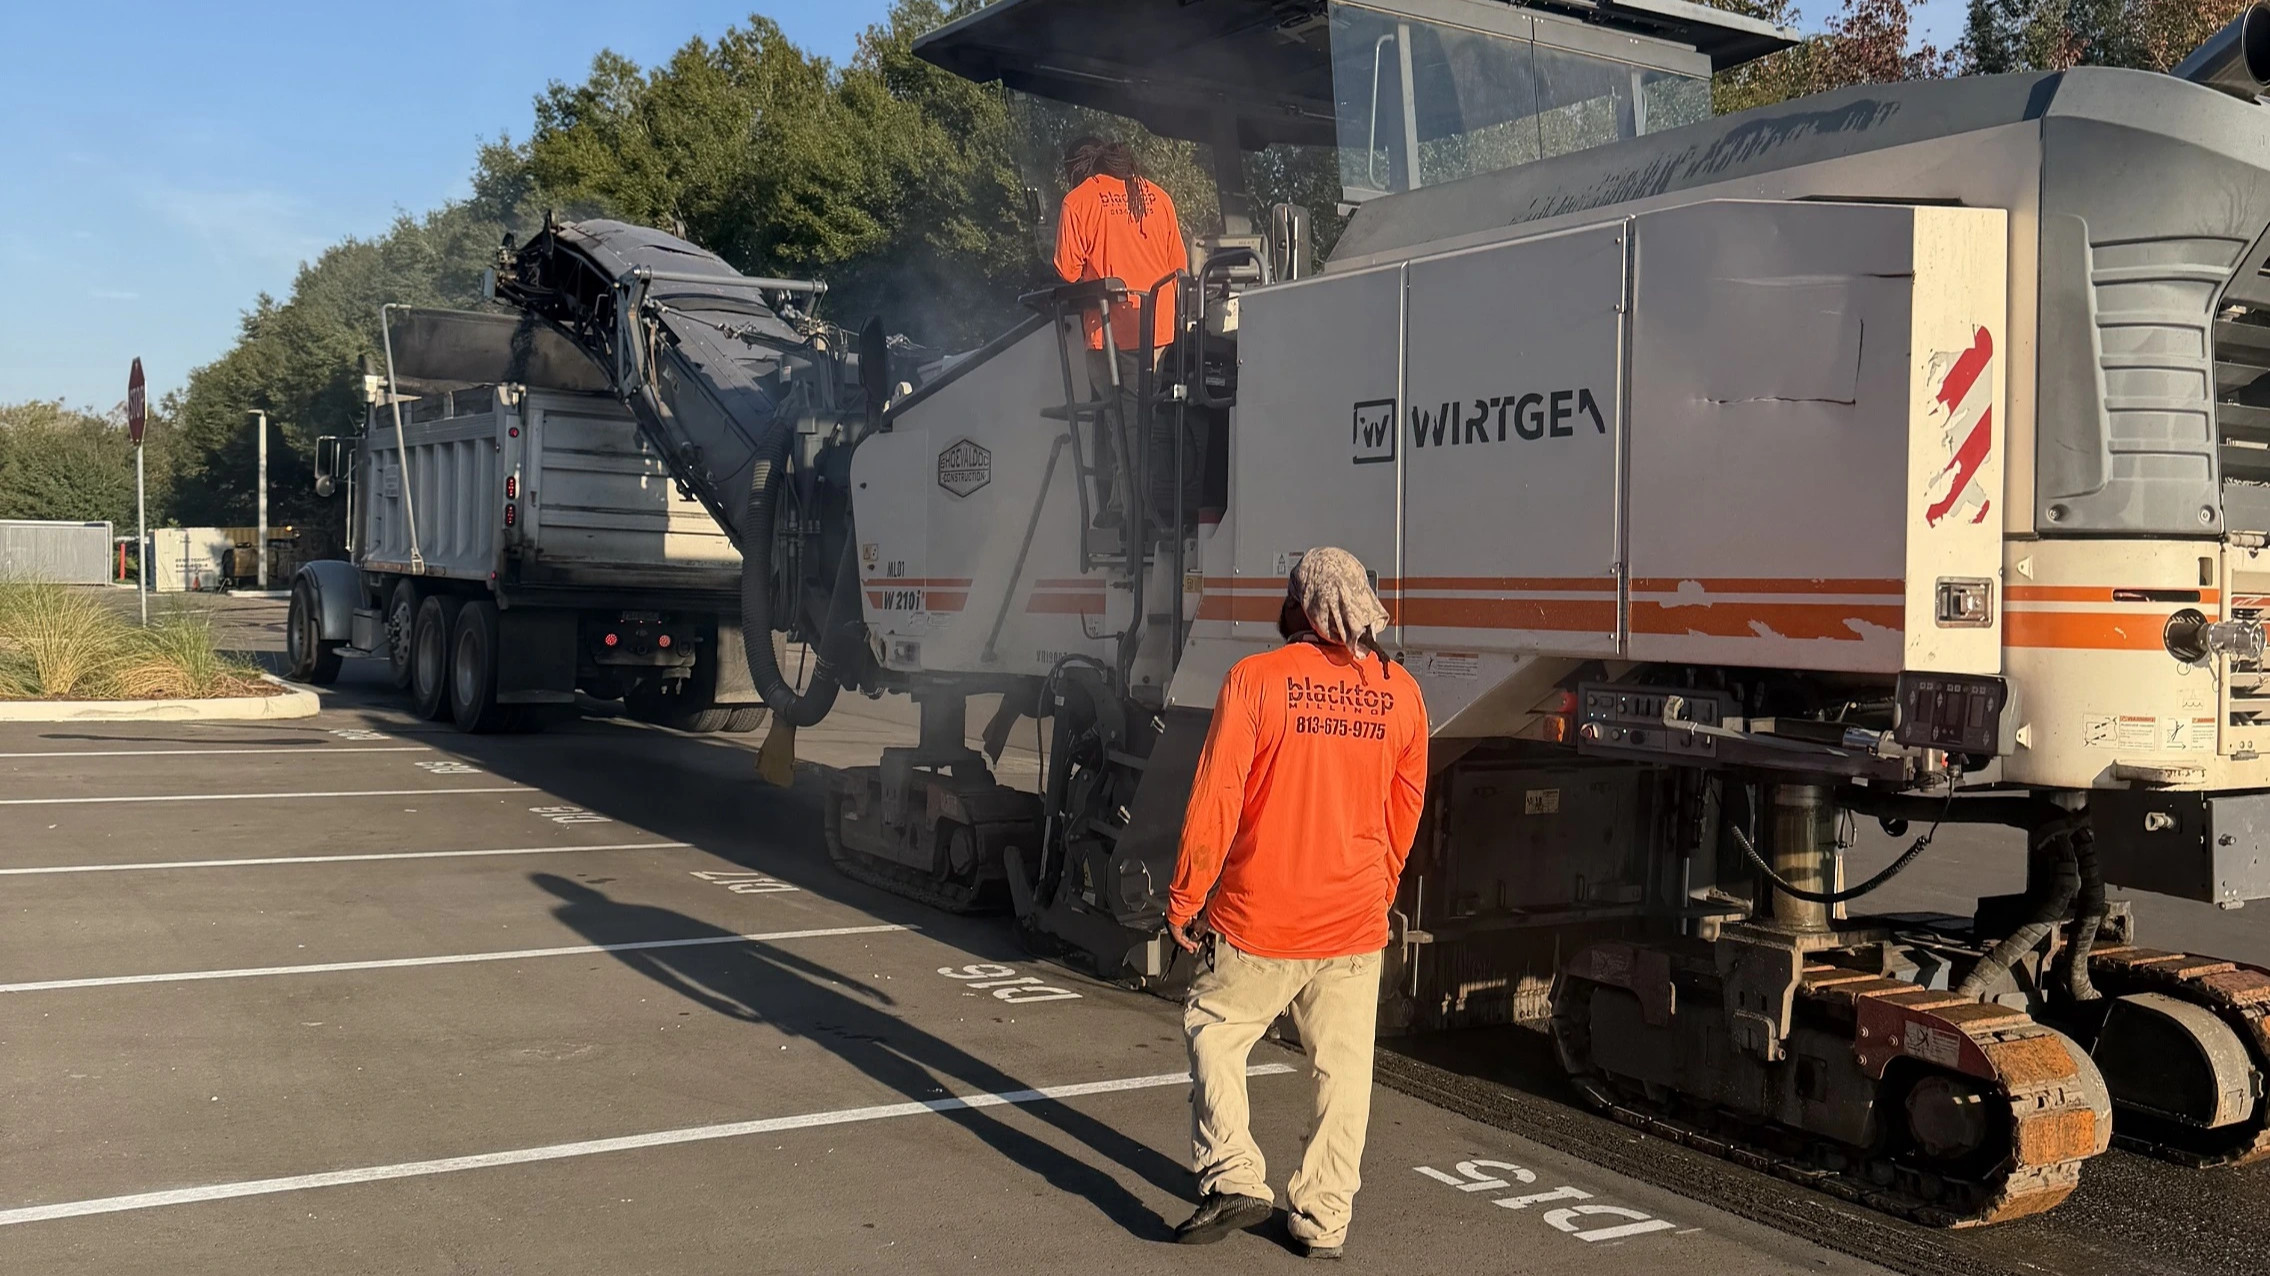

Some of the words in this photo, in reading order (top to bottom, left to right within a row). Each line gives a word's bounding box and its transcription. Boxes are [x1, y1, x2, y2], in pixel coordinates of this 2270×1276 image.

[129, 385, 144, 420] STOP
[942, 471, 986, 483] CONSTRUCTION
[886, 560, 906, 578] ML01
[883, 591, 895, 610] W
[895, 589, 921, 611] 210i
[1287, 676, 1395, 717] blacktop
[1288, 701, 1379, 716] MILLING
[1296, 716, 1386, 740] 813-675-9775
[689, 871, 800, 894] D17
[937, 964, 1083, 1004] D16
[1412, 1159, 1678, 1242] D15
